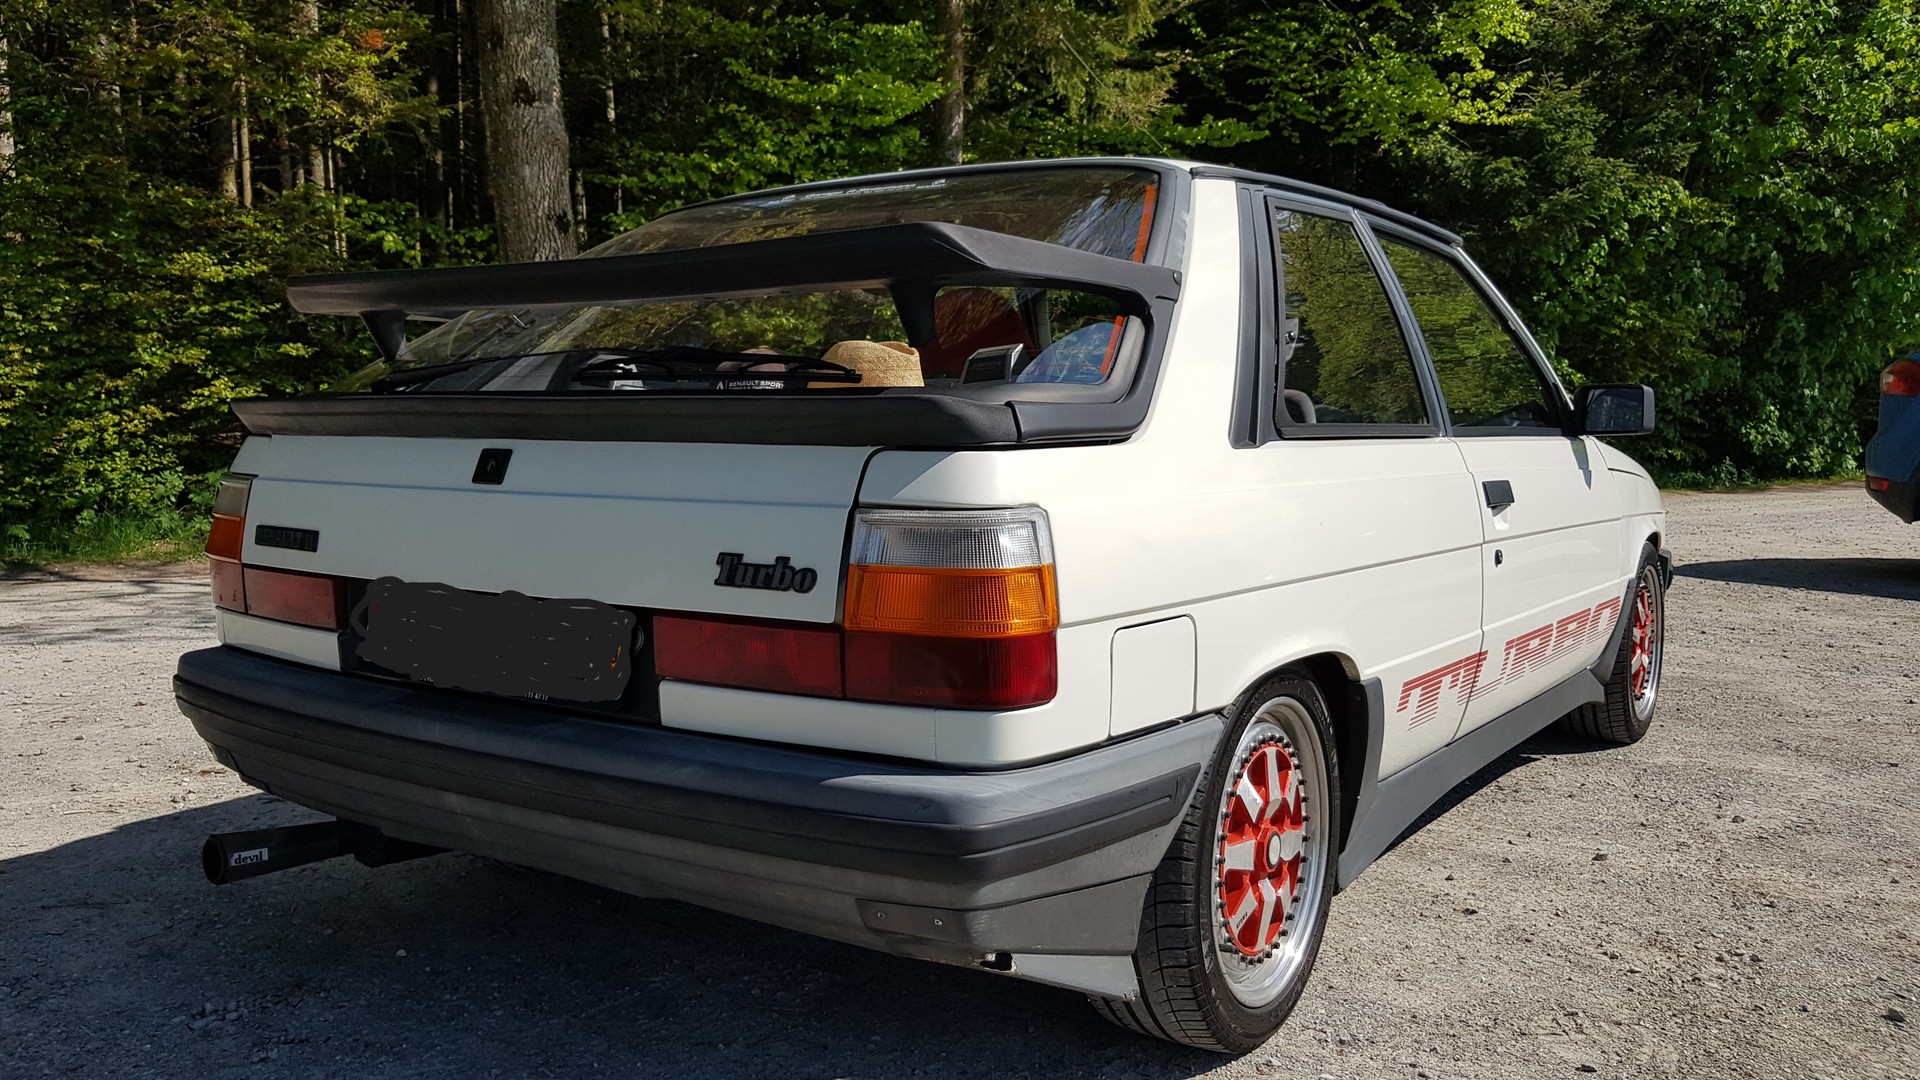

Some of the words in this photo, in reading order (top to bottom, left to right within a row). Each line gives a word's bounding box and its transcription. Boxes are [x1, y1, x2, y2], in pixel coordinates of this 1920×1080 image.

[760, 380, 785, 389] SPORT
[714, 552, 818, 594] Turbo
[1396, 596, 1621, 731] TURBO
[234, 850, 263, 864] devil
